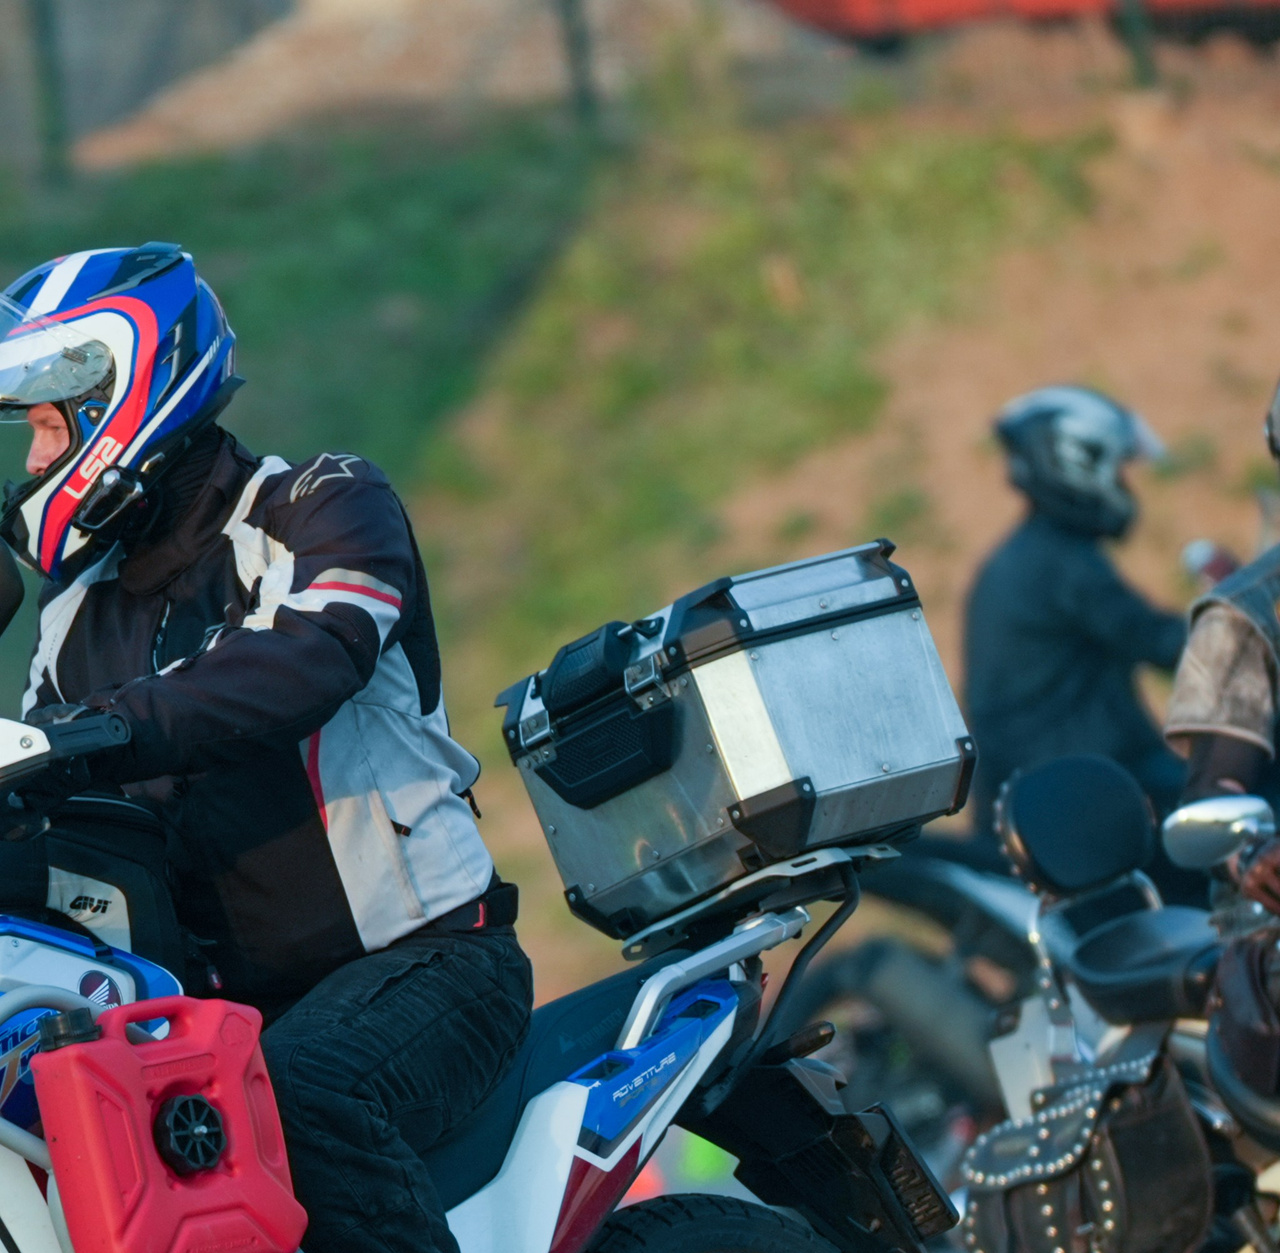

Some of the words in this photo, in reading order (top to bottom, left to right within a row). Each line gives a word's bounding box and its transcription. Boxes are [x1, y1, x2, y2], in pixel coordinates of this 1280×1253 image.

[63, 436, 124, 500] LS2
[69, 895, 110, 914] GIVI
[612, 1052, 676, 1102] ADVENTURE
